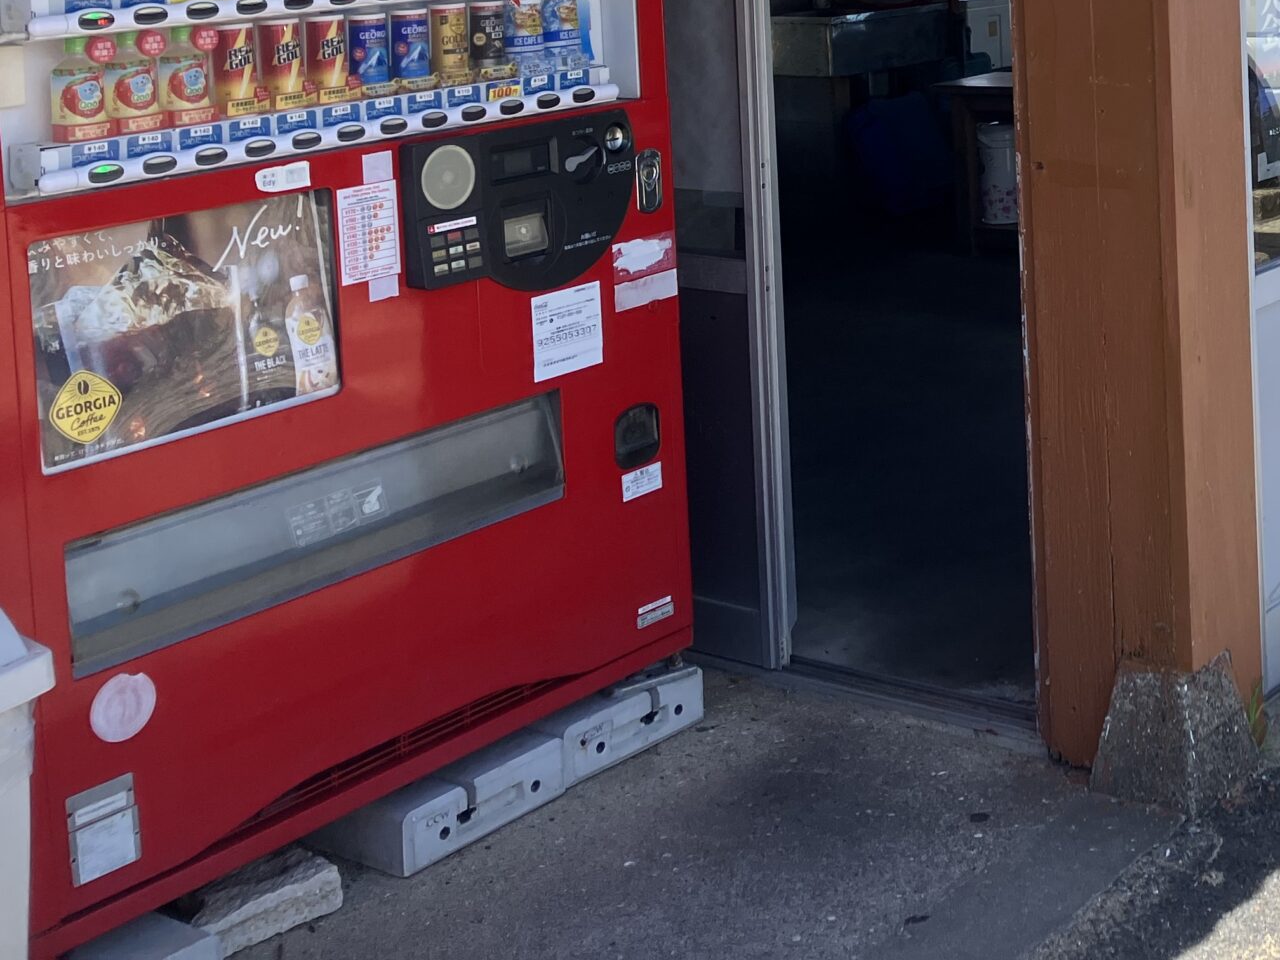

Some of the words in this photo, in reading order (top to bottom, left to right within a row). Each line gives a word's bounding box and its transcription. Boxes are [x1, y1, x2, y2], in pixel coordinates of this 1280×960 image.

[132, 94, 150, 102] Qoo
[186, 87, 202, 95] Qoo
[492, 87, 519, 98] 100円
[79, 101, 98, 110] Qoo
[87, 144, 105, 152] ¥140
[262, 179, 276, 187] Edy
[212, 194, 304, 272] New!
[298, 348, 310, 360] THE
[311, 342, 329, 356] LATTE
[254, 360, 267, 372] THE
[267, 354, 287, 369] BLACK
[55, 394, 116, 420] GEORGIA
[71, 412, 106, 431] Coffee
[425, 811, 449, 828] CCW
